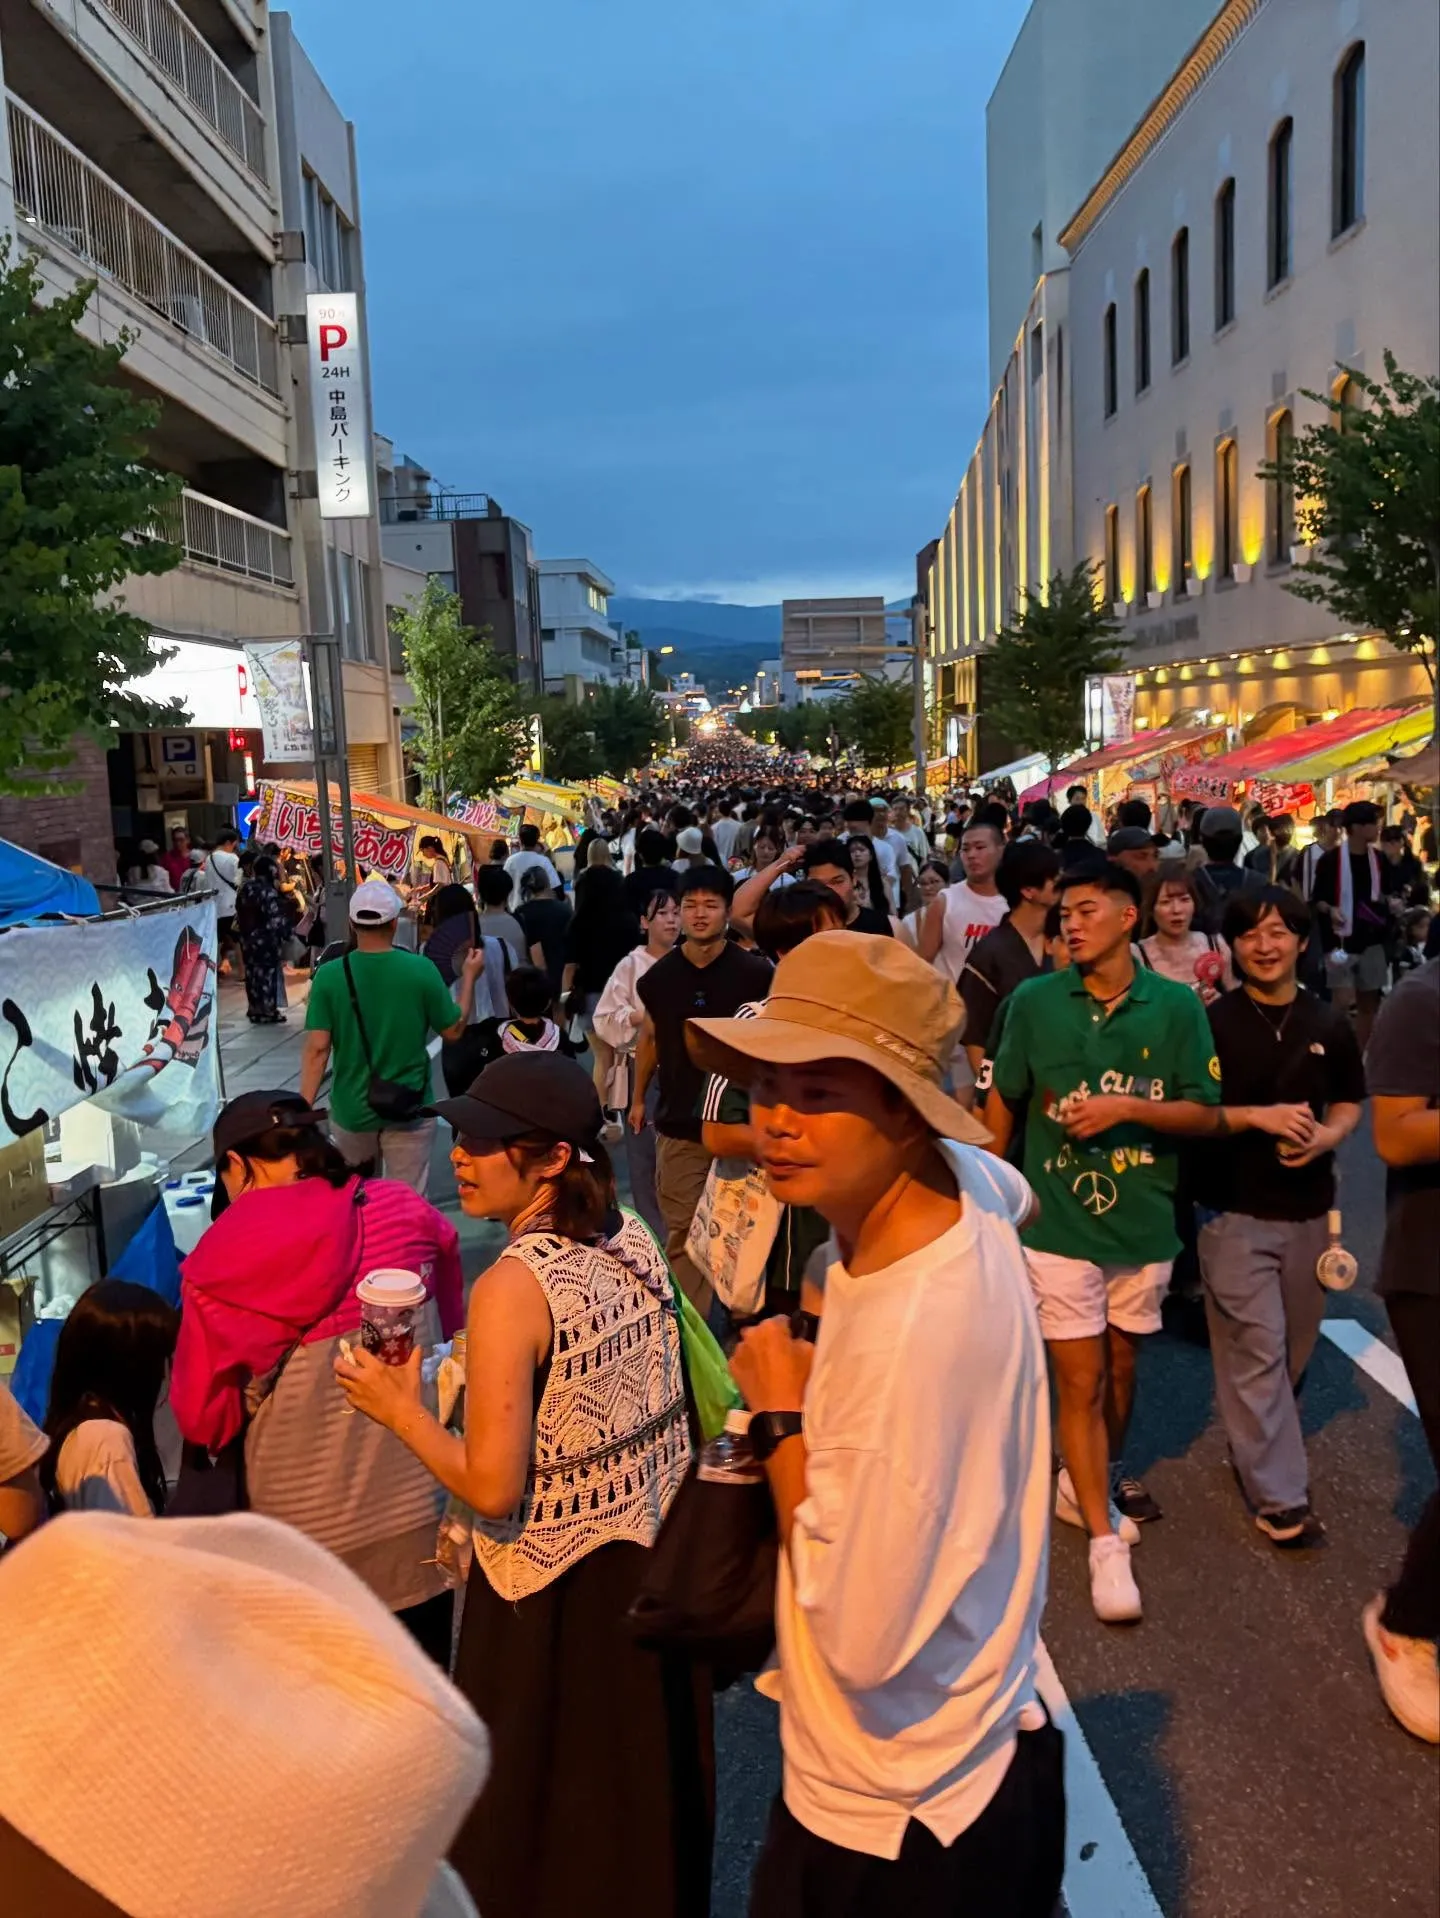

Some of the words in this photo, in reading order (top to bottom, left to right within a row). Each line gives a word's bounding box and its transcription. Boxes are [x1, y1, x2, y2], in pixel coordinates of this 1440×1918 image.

[319, 325, 348, 362] P
[321, 366, 350, 379] 24H
[328, 388, 352, 503] 中島パーキング
[166, 738, 191, 760] P
